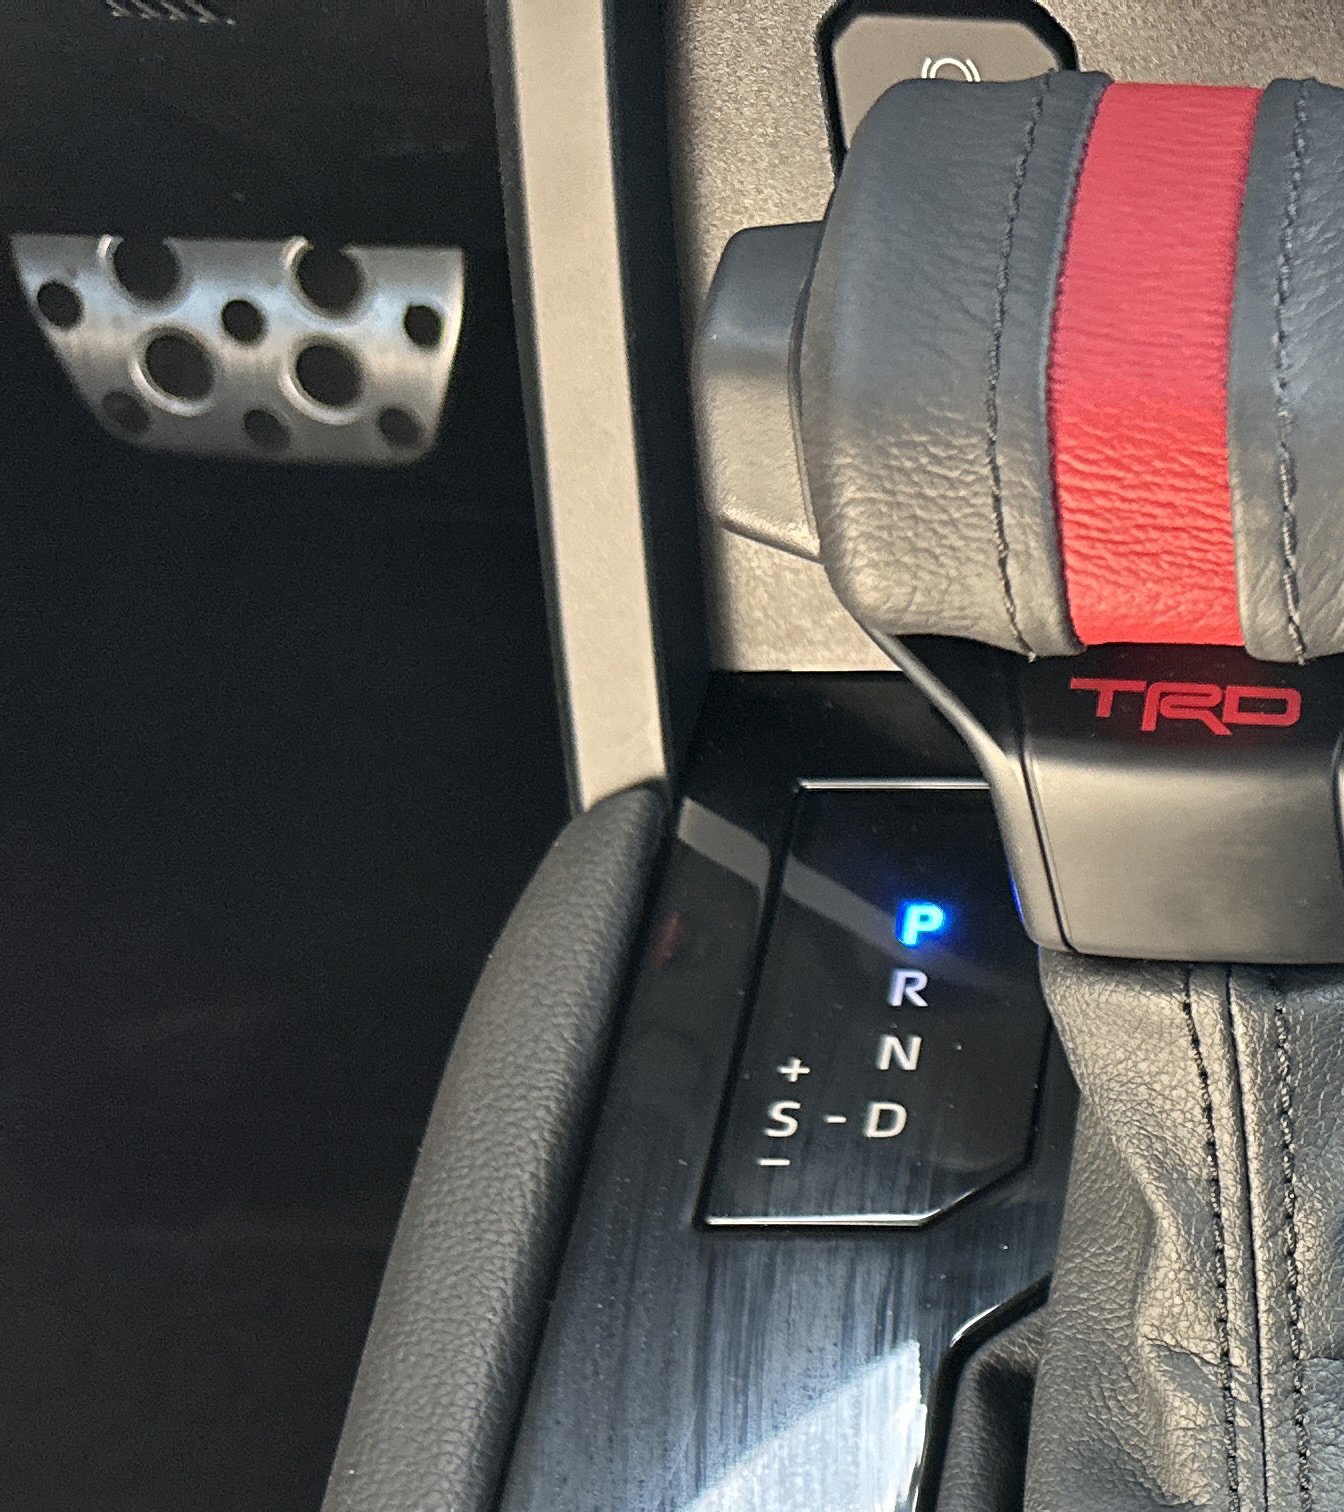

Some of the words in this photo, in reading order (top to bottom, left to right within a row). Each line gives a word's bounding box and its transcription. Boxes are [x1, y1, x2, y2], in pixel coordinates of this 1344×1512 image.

[1070, 677, 1301, 736] TRD
[900, 901, 945, 945] P
[889, 967, 928, 1007] R
[876, 1034, 922, 1071] N
